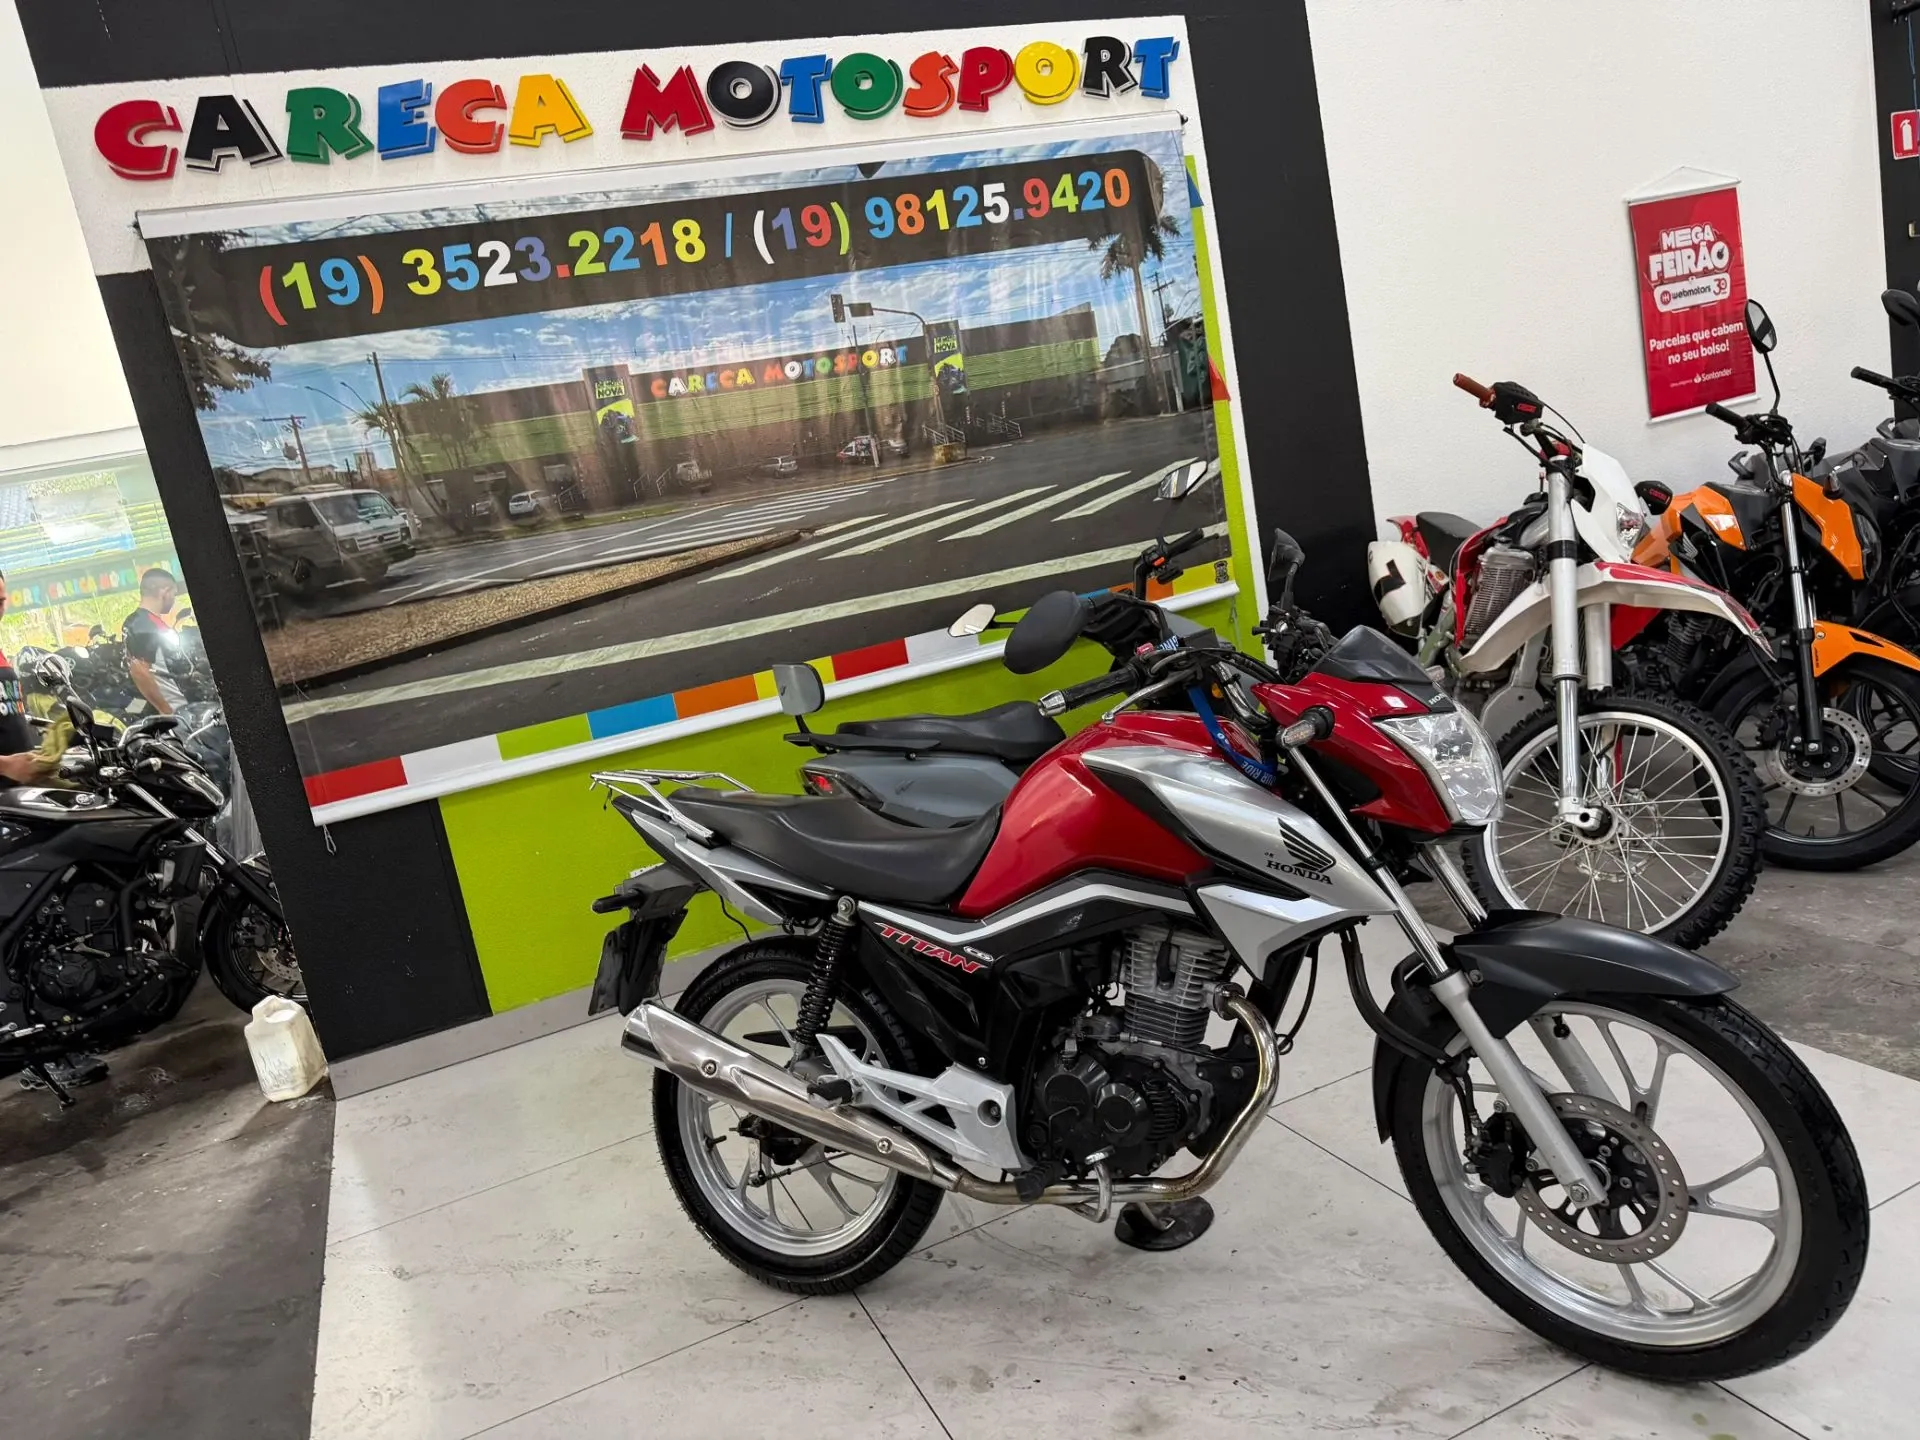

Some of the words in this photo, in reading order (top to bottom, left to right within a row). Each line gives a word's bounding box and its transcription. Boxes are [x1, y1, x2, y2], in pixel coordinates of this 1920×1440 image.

[94, 73, 594, 181] CARECA
[619, 35, 1180, 141] MOTOSPORT
[260, 254, 385, 326] (19)
[402, 218, 706, 296] 3523.2218
[724, 212, 734, 259] /
[753, 201, 851, 265] (19)
[865, 167, 1131, 239] 98125.9420
[1661, 224, 1715, 250] MEGA
[1649, 241, 1729, 281] FEIRÃO
[1672, 284, 1711, 300] webmotors
[1649, 332, 1692, 352] Parcelas
[1692, 328, 1710, 345] que
[1711, 322, 1744, 337] cabem
[1668, 355, 1681, 365] no
[1682, 350, 1699, 362] seu
[1700, 339, 1730, 357] bolso!
[651, 367, 755, 398] CARECA
[763, 345, 908, 382] MOTOSPORT
[1701, 368, 1732, 382] Santander
[1266, 860, 1334, 886] HONDA
[873, 922, 989, 974] TITAN
